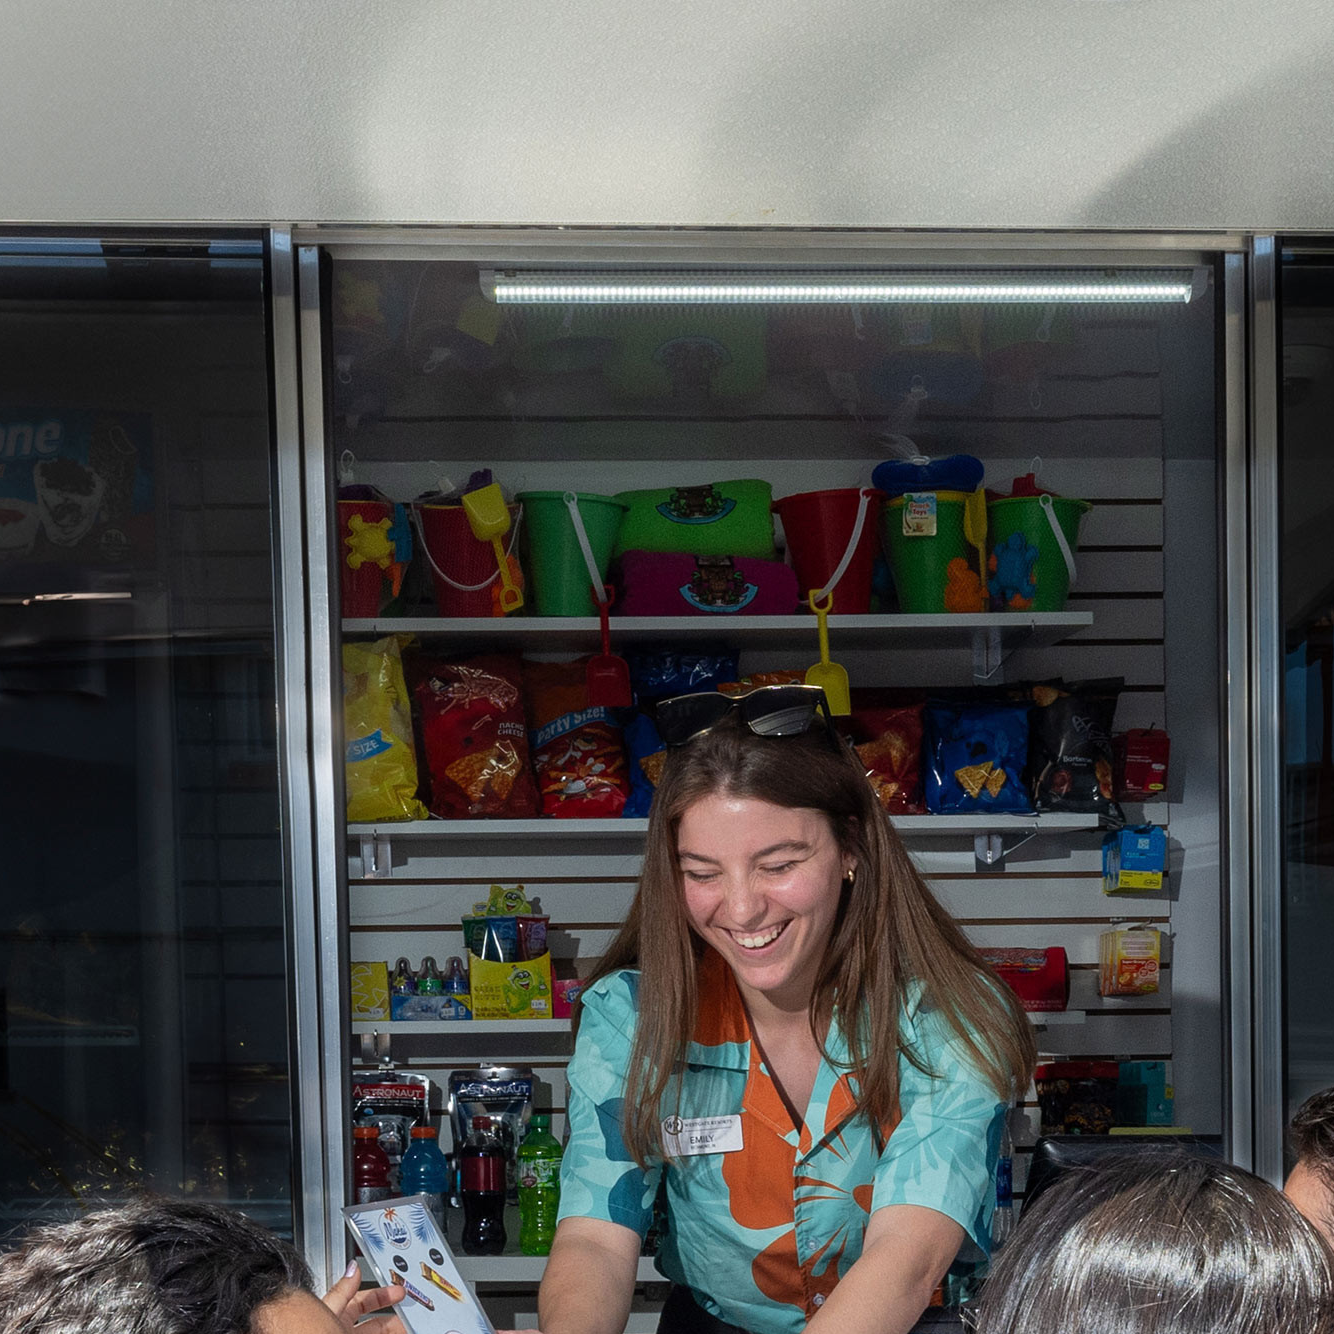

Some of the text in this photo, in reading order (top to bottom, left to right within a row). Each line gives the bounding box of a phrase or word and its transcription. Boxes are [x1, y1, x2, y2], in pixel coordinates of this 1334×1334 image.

[498, 722, 524, 730] NACHO
[536, 716, 571, 744] Party
[497, 729, 525, 738] CHEESE
[354, 739, 380, 756] SIZE
[352, 1085, 423, 1097] ASTRONAUT
[457, 1082, 529, 1095] ASTRONAUT
[689, 1134, 715, 1144] EMILY
[383, 1222, 408, 1240] Makai
